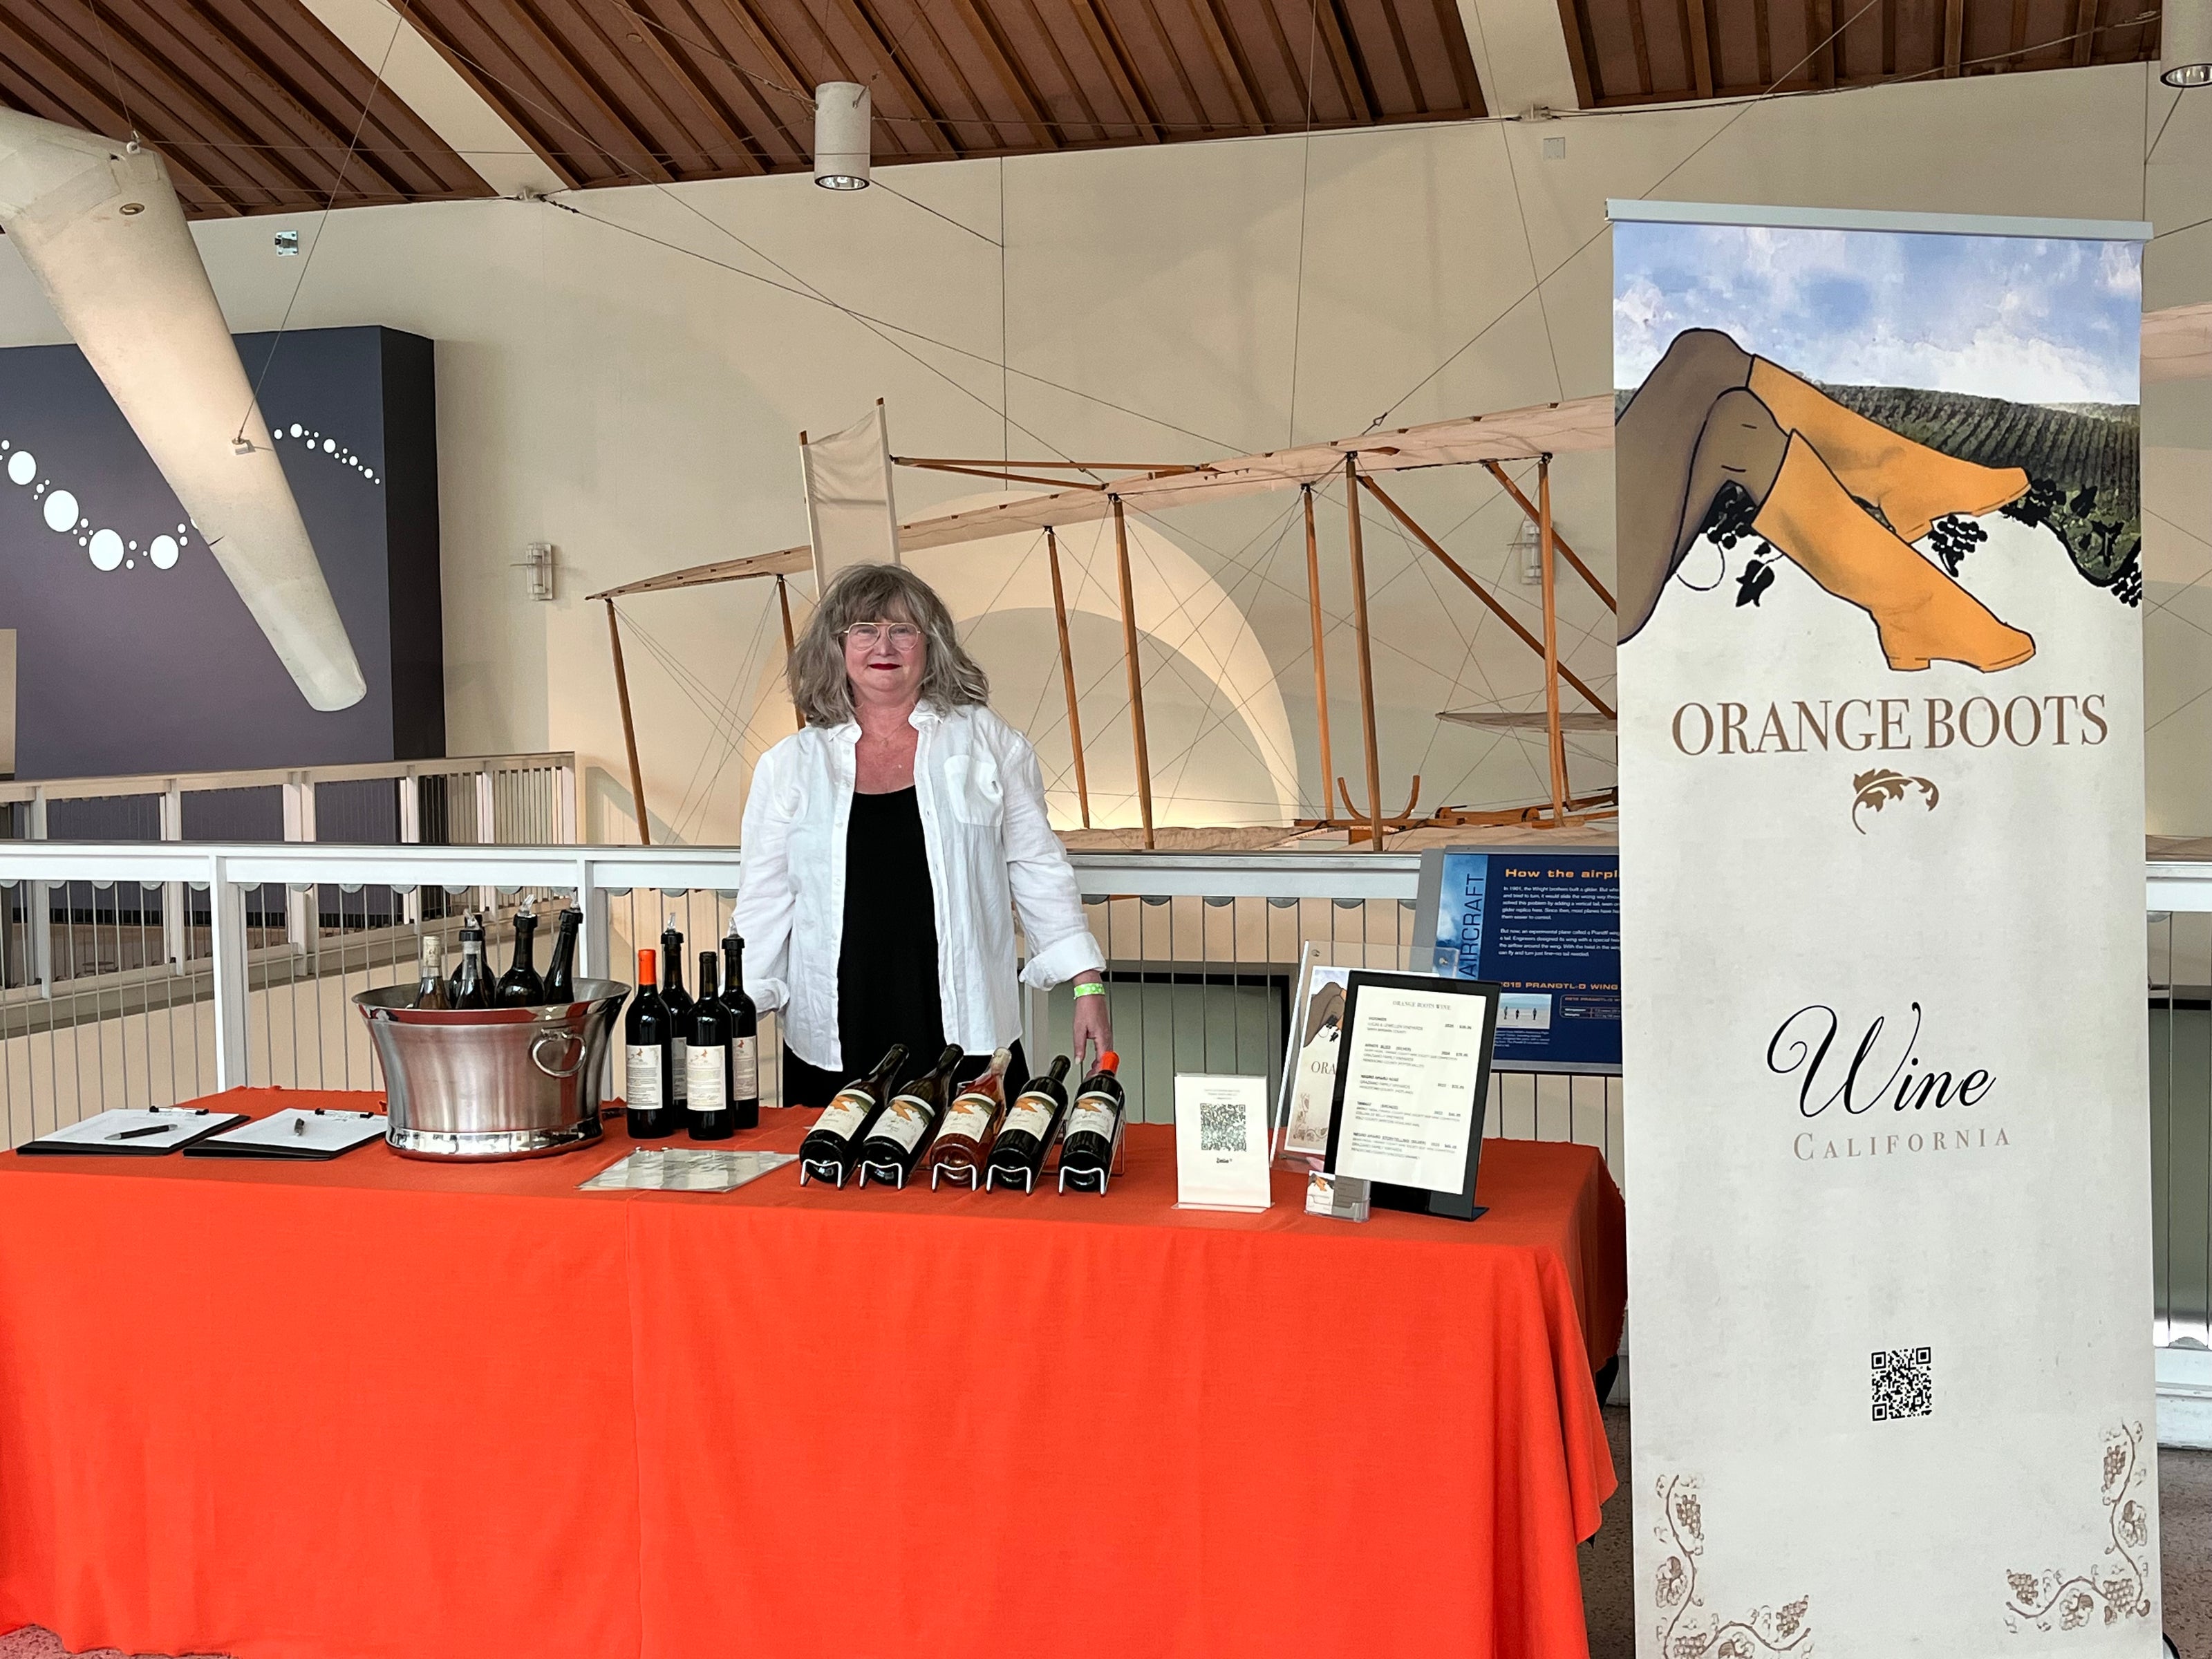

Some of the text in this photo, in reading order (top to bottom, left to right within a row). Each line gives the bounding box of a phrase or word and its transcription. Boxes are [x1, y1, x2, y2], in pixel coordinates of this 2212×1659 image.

[1671, 694, 2108, 756] ORANGE BOOTS
[1505, 868, 1620, 880] How the airpl
[1459, 874, 1484, 977] AIRCRAFT
[1526, 982, 1586, 990] PRANDTL-D
[1311, 1060, 1336, 1075] ORA
[1767, 1002, 1997, 1118] Wine
[1793, 1127, 2010, 1161] CALIFORNIA
